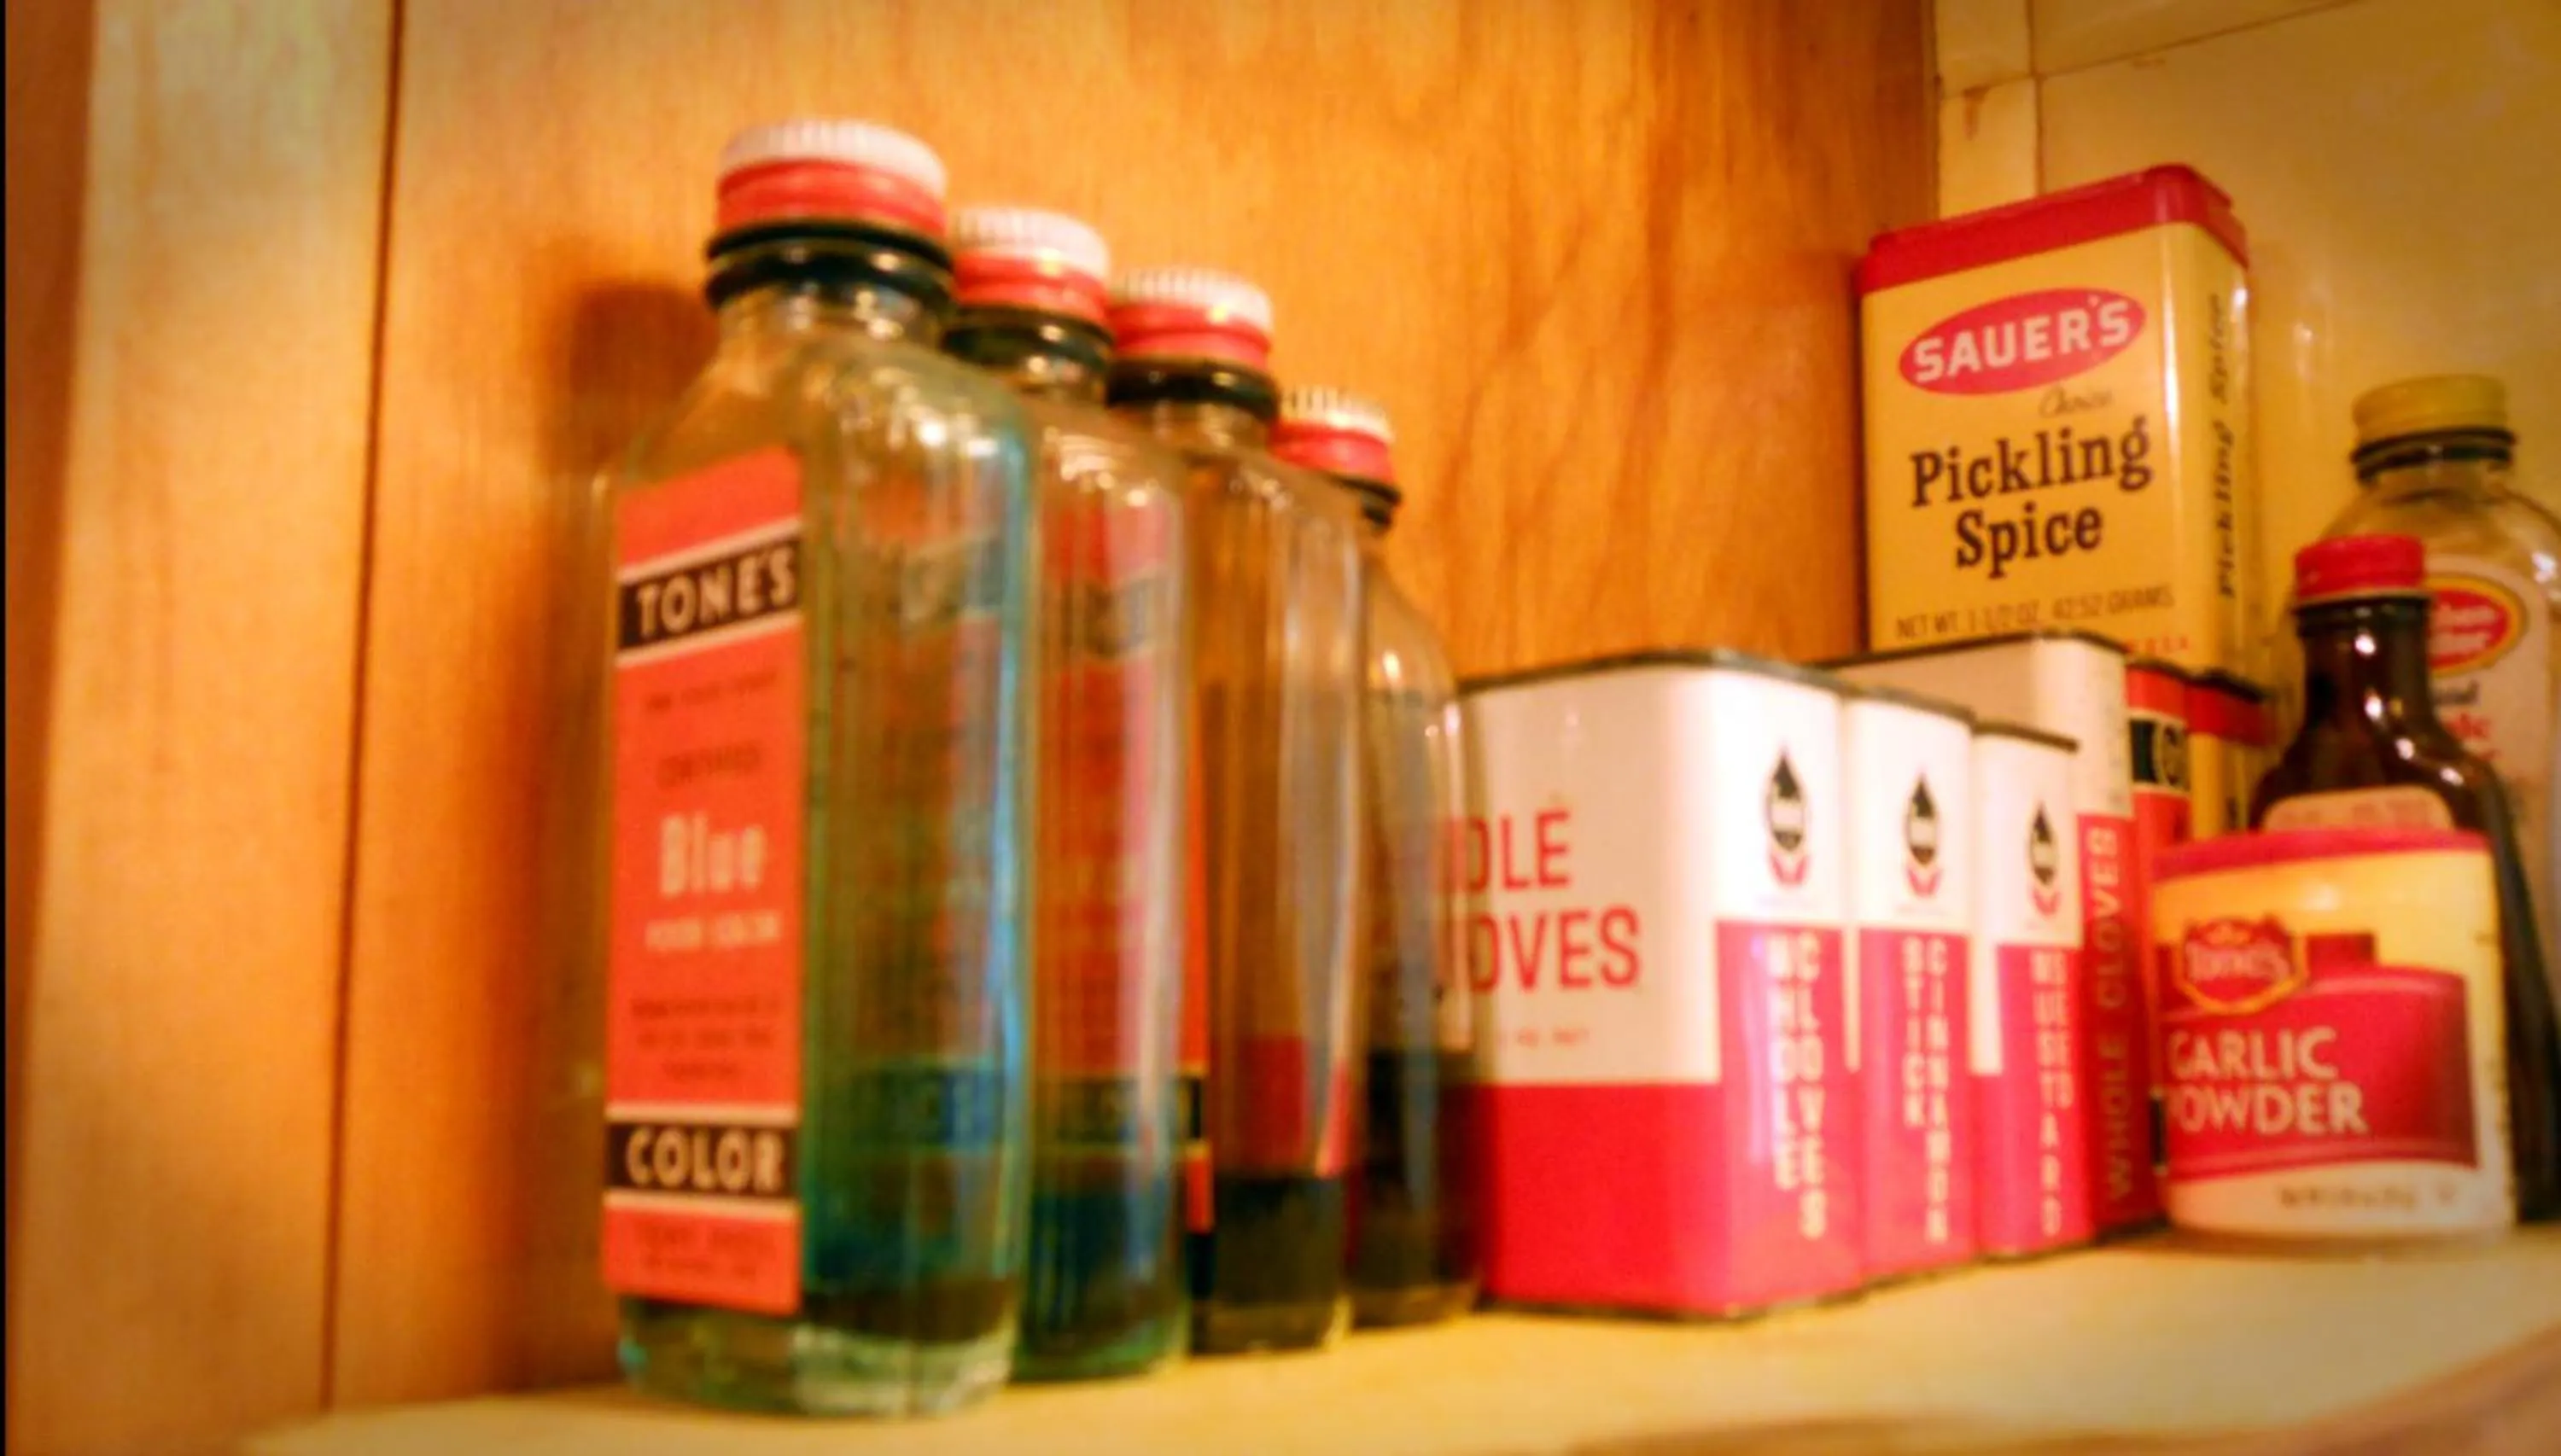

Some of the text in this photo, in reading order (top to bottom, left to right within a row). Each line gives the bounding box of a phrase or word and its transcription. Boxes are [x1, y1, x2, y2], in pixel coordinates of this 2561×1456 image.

[1912, 294, 2132, 384] SAUER'S
[1909, 414, 2152, 510] Pickling
[1955, 501, 2103, 580] Spice
[637, 545, 796, 638] TONE'S
[1897, 614, 1928, 639] NET
[660, 812, 765, 899] Blue
[1446, 811, 1572, 891] OLE
[1446, 905, 1641, 992] OVES
[2090, 828, 2127, 1009] CLOVES
[627, 1128, 784, 1191] COLOR
